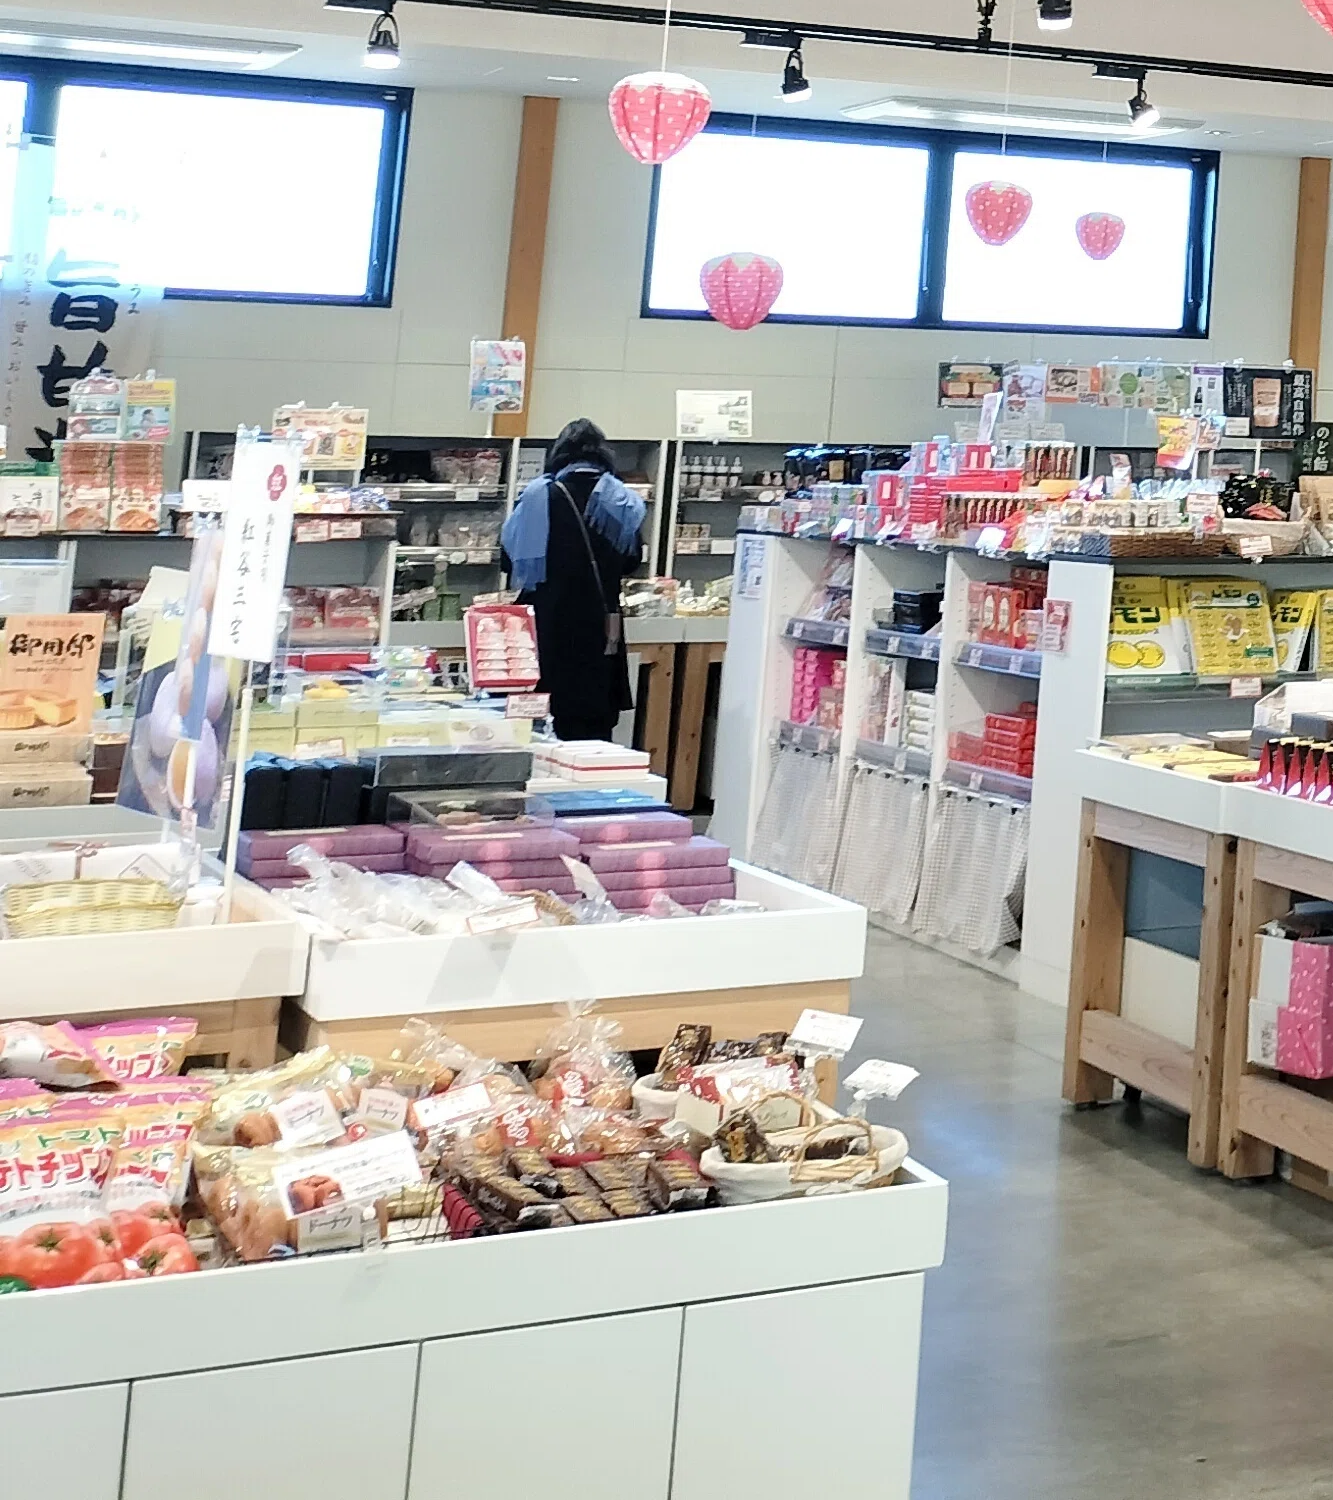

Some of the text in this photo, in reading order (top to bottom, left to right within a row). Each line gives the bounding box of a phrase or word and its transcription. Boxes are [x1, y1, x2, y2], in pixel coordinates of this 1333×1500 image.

[1313, 426, 1330, 472] のど飴
[1109, 606, 1161, 624] モン
[8, 633, 96, 659] 御用邸
